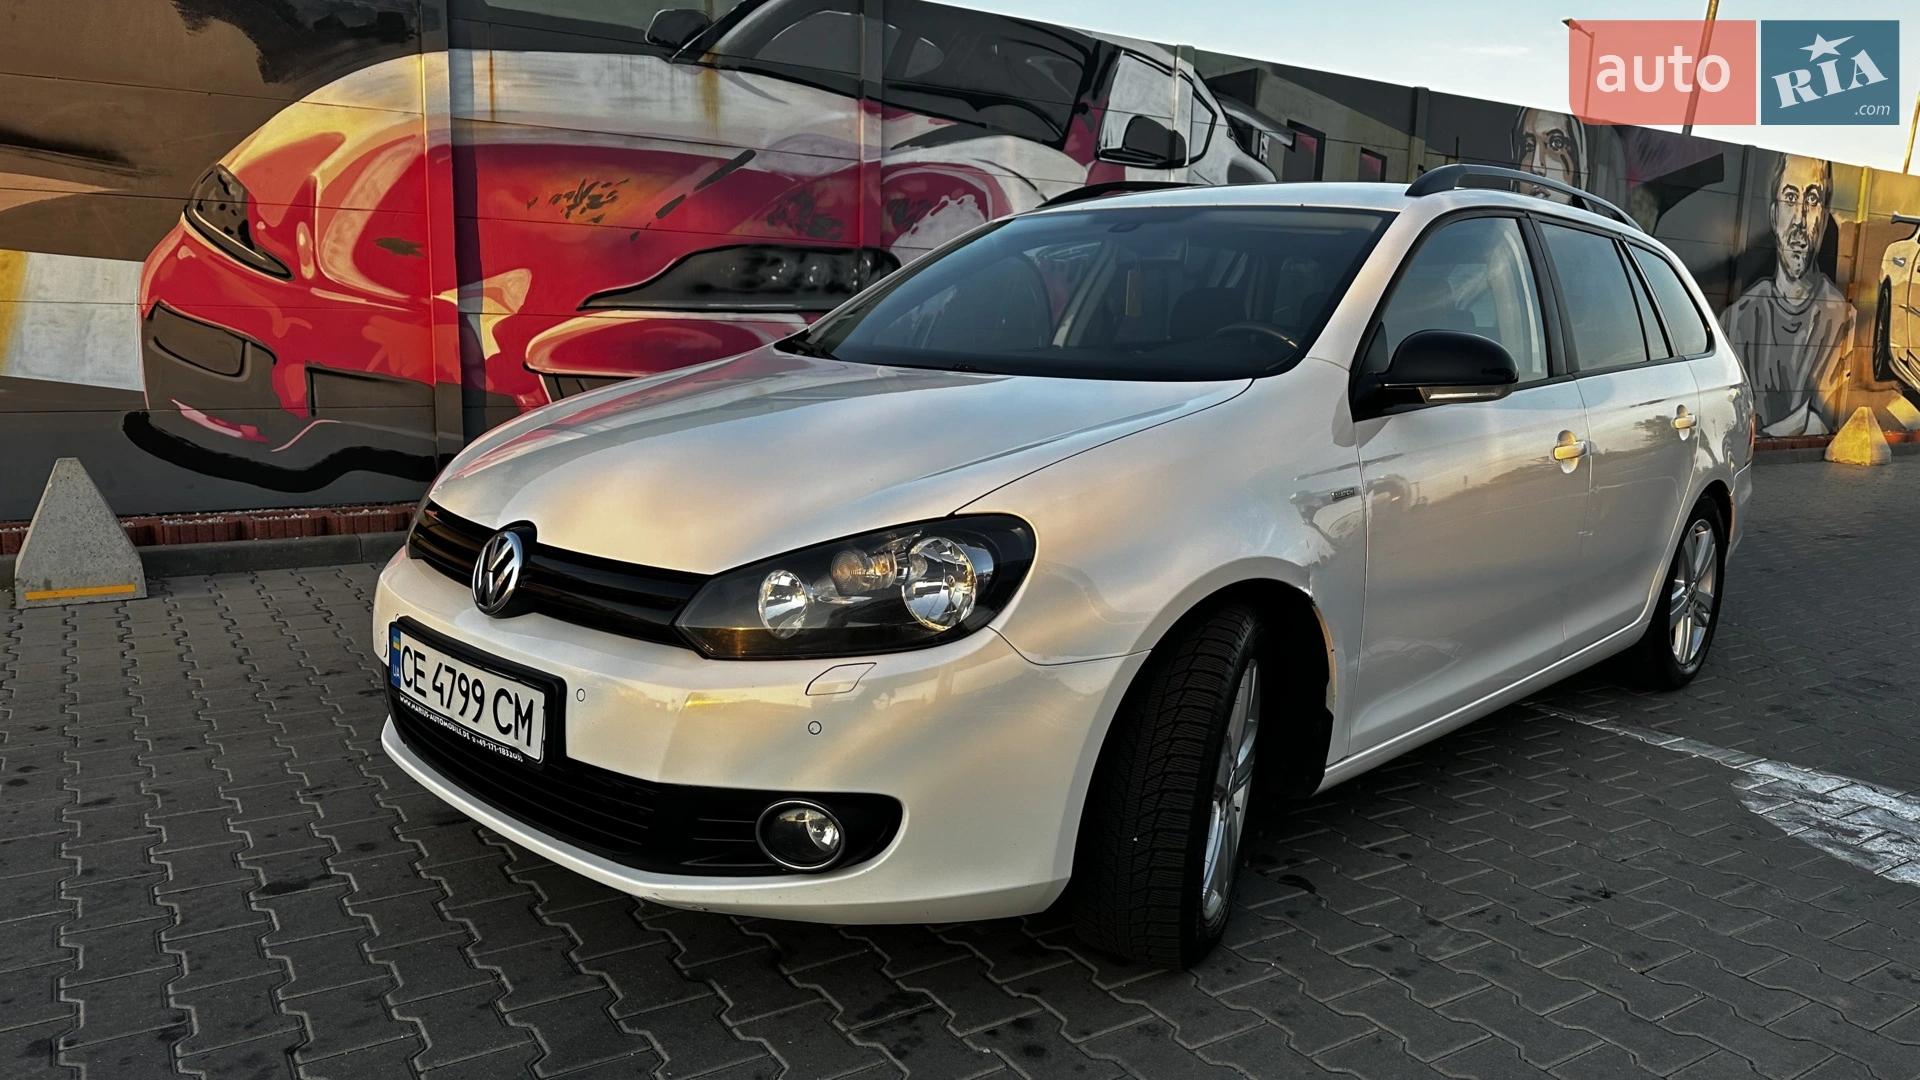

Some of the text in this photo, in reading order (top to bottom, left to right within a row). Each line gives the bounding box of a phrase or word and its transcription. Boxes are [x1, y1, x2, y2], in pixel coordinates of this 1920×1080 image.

[392, 663, 400, 678] UA
[402, 645, 534, 747] CE 4799 CM
